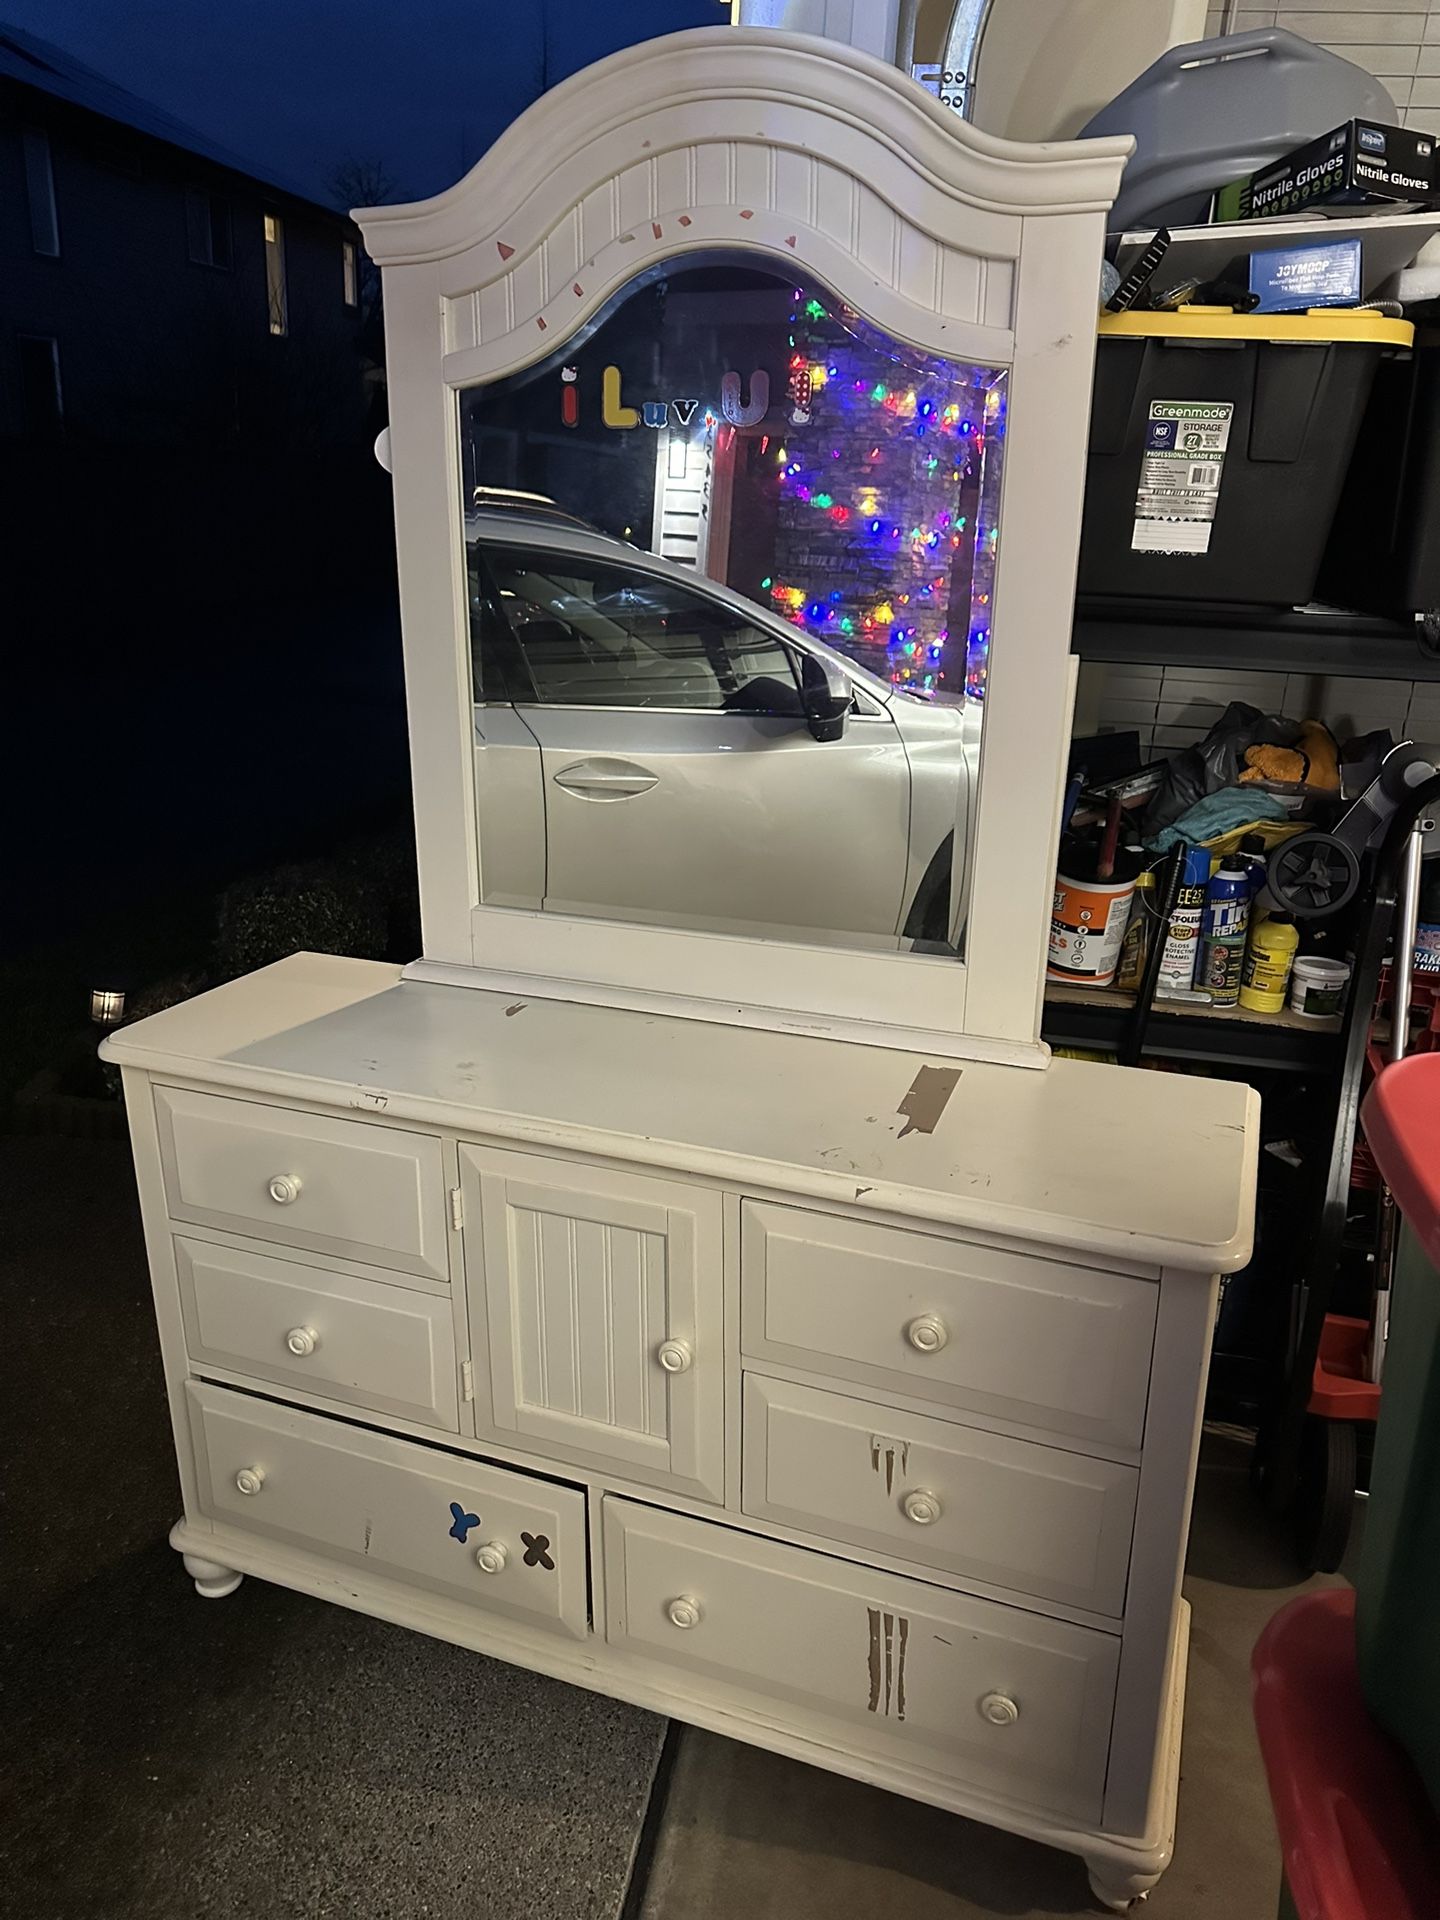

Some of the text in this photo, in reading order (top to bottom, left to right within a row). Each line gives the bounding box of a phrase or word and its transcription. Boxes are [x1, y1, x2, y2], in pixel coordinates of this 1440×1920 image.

[1252, 179, 1293, 210] Nitrile
[1296, 154, 1344, 187] Gloves
[1356, 163, 1430, 191] Nitrile Gloves
[601, 365, 699, 430] Luv
[1153, 405, 1227, 419] Greenmade
[1155, 427, 1168, 436] NSF
[1183, 423, 1223, 432] STORAGE
[1187, 435, 1198, 445] 27
[1146, 451, 1188, 459] PROFESSIONAL
[1188, 452, 1208, 460] GRADE
